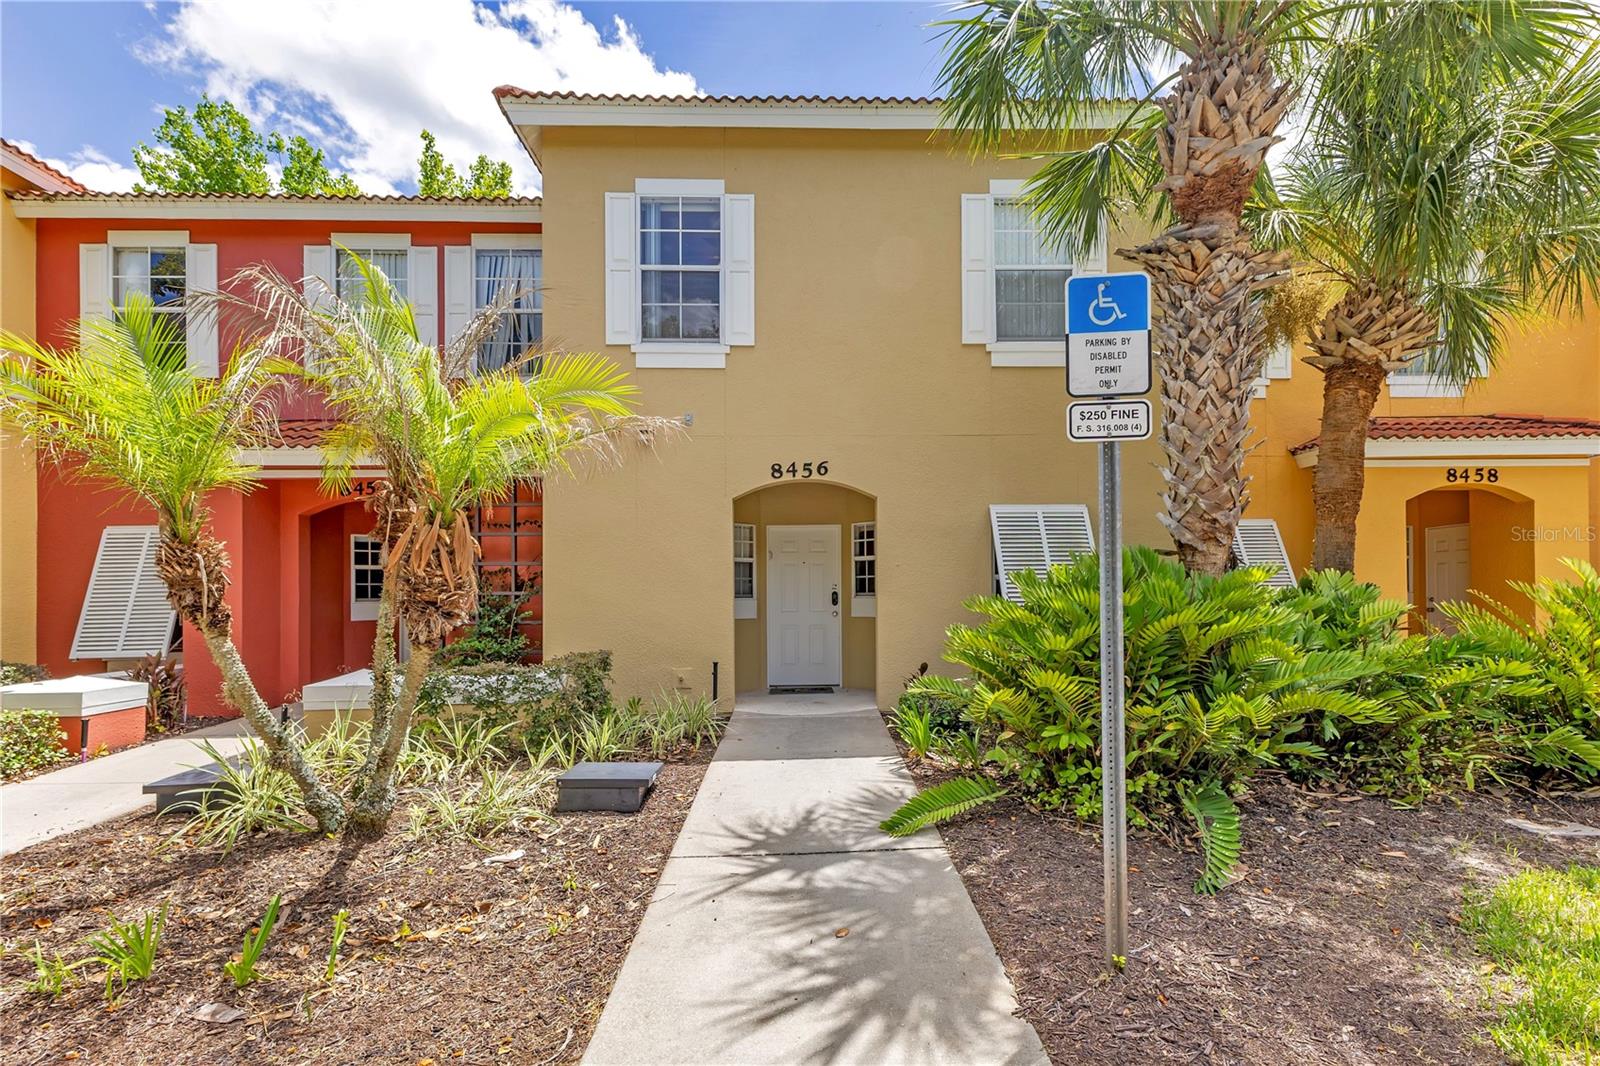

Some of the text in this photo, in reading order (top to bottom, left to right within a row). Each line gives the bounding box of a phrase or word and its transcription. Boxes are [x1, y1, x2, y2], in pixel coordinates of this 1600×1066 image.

[1085, 337, 1132, 347] PARKING BY
[1090, 351, 1127, 361] DISABLED
[1095, 365, 1122, 374] PERMIT
[1099, 379, 1118, 388] ONLY
[1079, 409, 1139, 421] $250 FINE
[1096, 424, 1129, 432] 316.008
[1131, 423, 1142, 432] (4)
[771, 460, 829, 479] 8456
[1446, 467, 1499, 483] 8458
